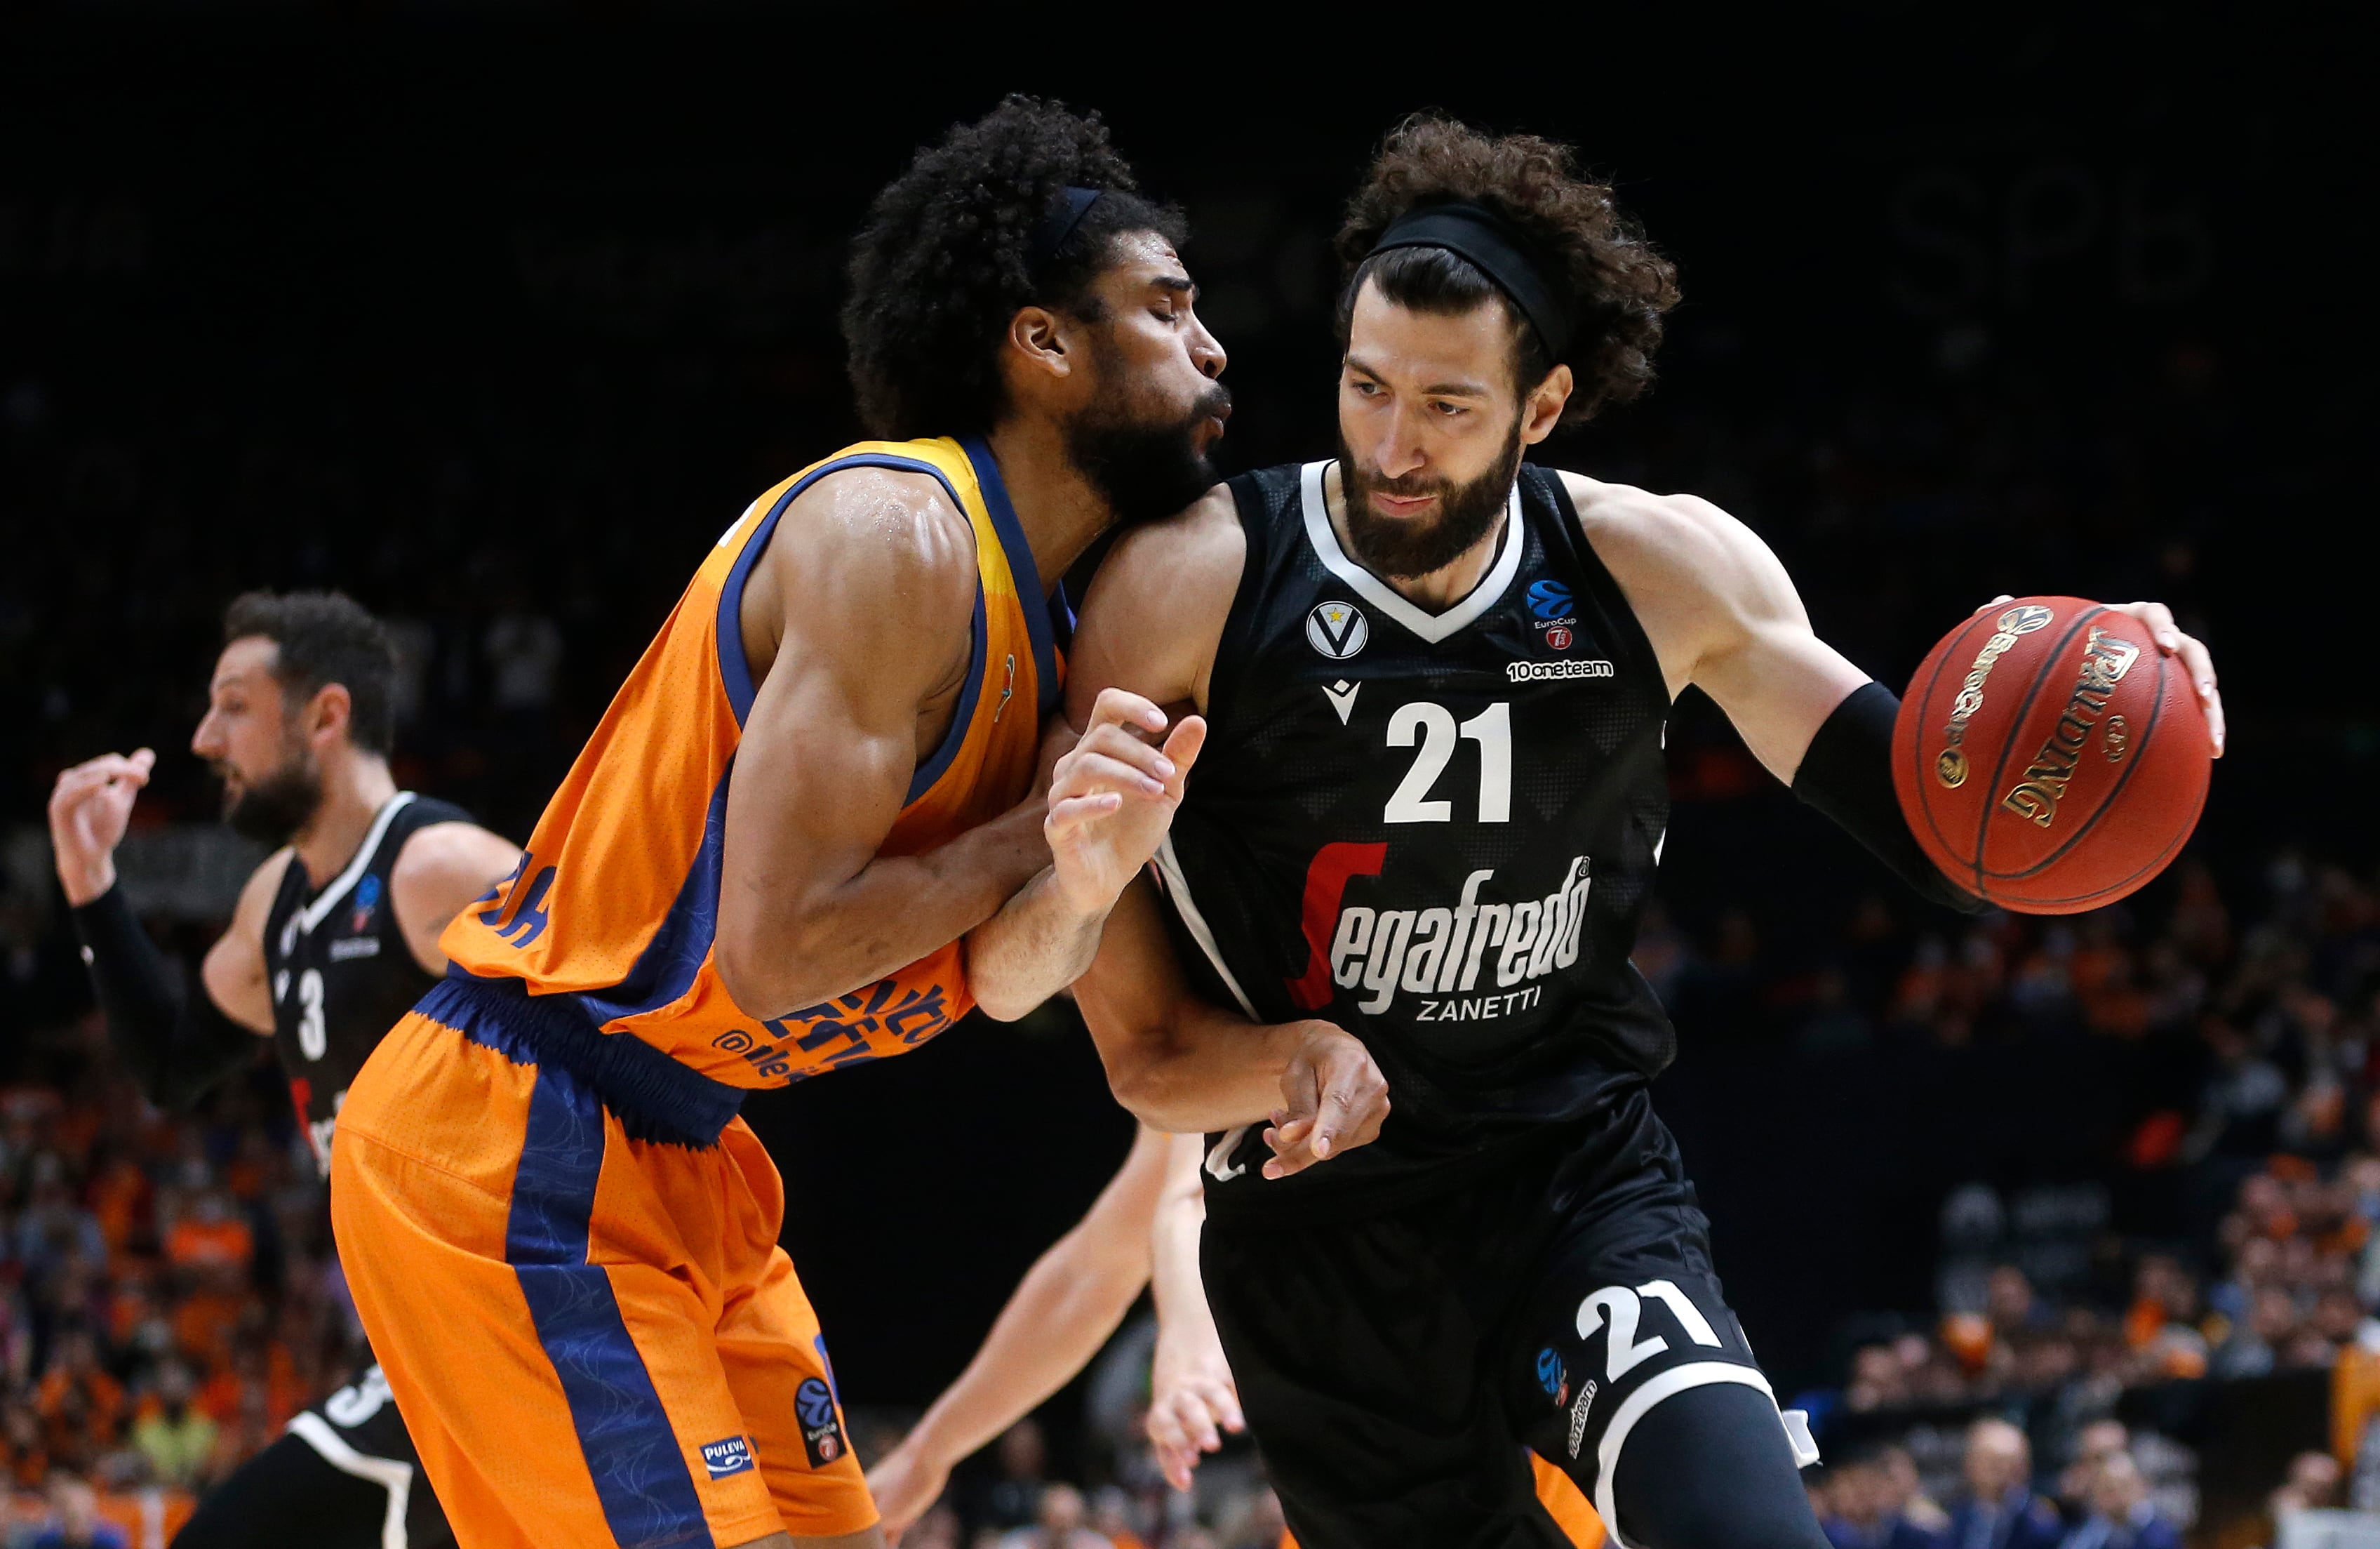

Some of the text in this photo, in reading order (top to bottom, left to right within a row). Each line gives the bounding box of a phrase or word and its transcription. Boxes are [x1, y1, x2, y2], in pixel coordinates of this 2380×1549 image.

[1535, 618, 1577, 629] EuroCup
[1506, 659, 1614, 682] 10oneteam
[1384, 702, 1511, 823] 21
[1286, 842, 1591, 1015] Segafredo
[298, 968, 327, 1061] 3
[1416, 985, 1541, 1021] ZANETTI
[1577, 1279, 1723, 1383] 21
[704, 1440, 745, 1461] PULEVA
